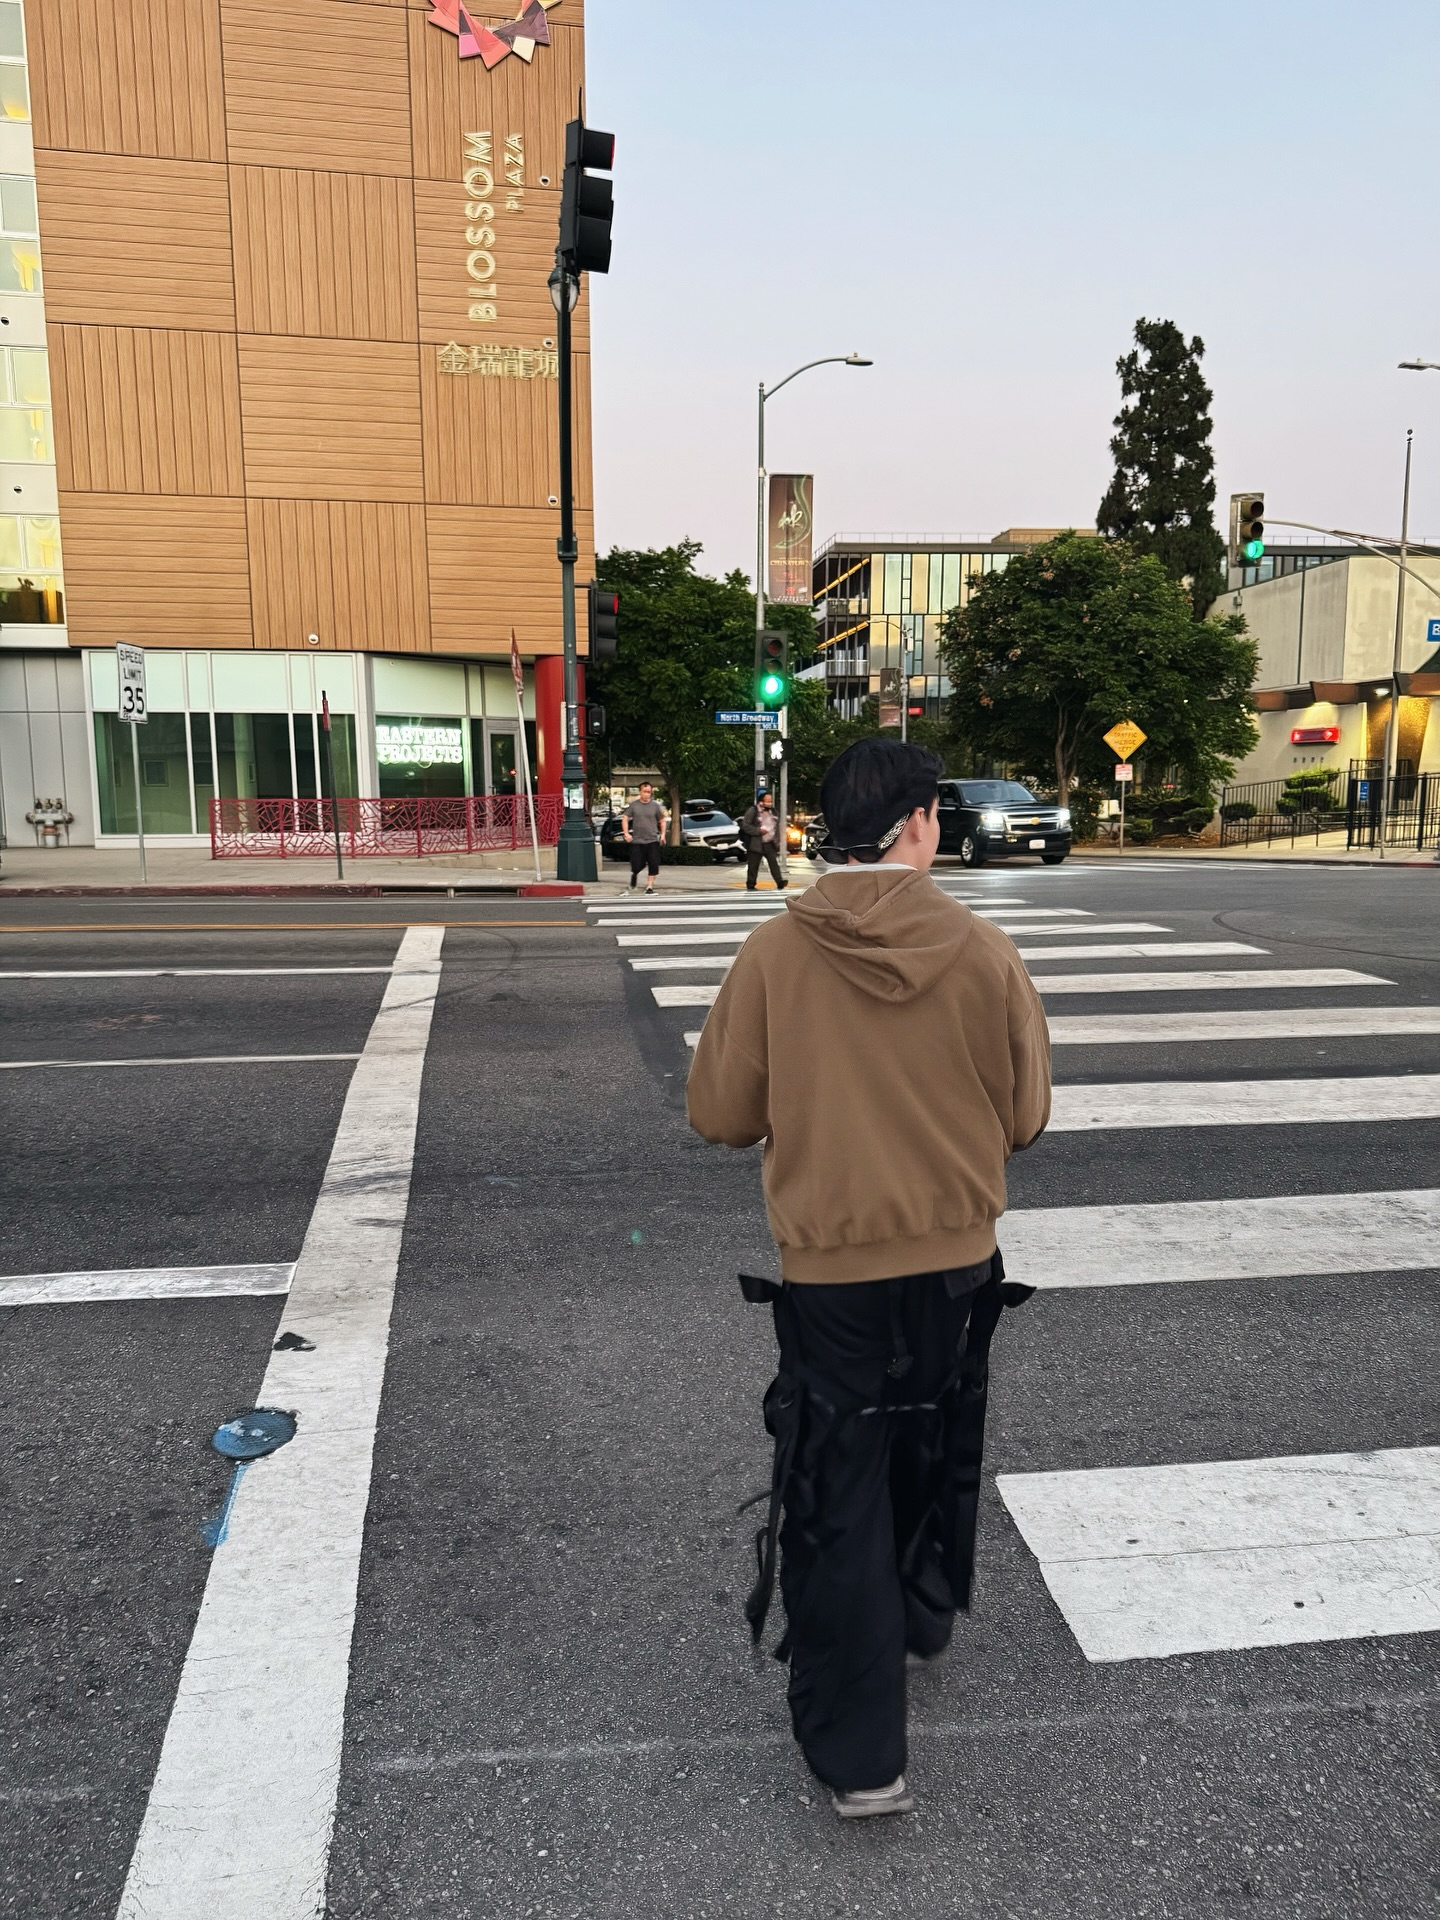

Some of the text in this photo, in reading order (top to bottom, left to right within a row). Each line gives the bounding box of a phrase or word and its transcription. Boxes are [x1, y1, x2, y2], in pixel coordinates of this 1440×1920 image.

[504, 134, 525, 212] PLAZA
[463, 131, 496, 322] BLOSSOM
[120, 650, 142, 664] SPEED
[124, 668, 142, 681] LIMIT
[124, 686, 144, 715] 35
[720, 713, 775, 723] North Broadway
[375, 726, 462, 745] EASTERN
[376, 745, 463, 763] PROJECTS
